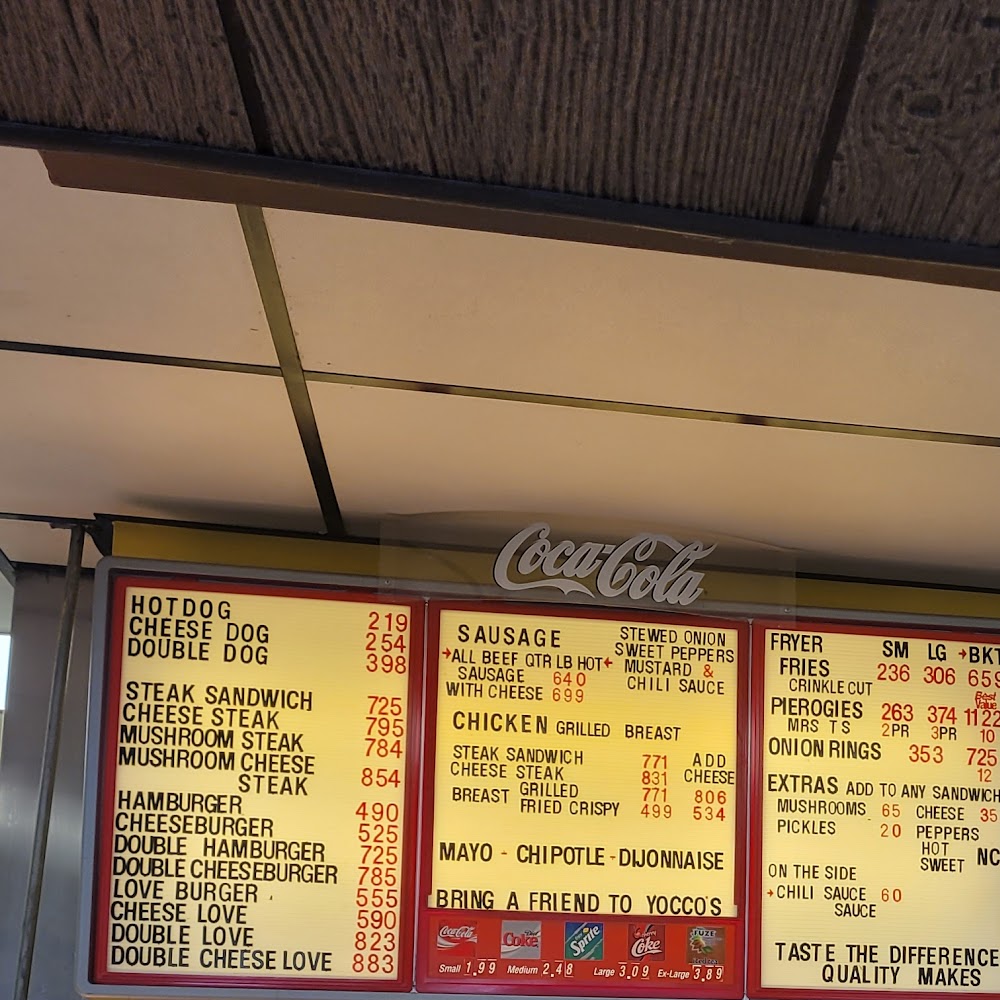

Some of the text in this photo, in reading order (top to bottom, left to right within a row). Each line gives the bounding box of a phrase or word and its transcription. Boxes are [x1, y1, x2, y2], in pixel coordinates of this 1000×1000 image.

[129, 616, 406, 653] CHEESE DOG 254
[458, 624, 561, 648] SAUSAGE
[771, 633, 823, 653] FRYER
[883, 640, 908, 659] SM
[928, 643, 946, 661] LG
[780, 658, 830, 677] FRIES
[877, 663, 910, 681] 236
[924, 666, 955, 685] 306
[446, 682, 584, 703] WITH CHEESE 699
[789, 678, 873, 696] CRINKLE CUT
[452, 711, 681, 741] CHICKEN GRILLED BREAST
[768, 774, 1000, 803] EXTRAS ADD TO ANY SANDWICH
[118, 791, 398, 822] HAMBURGER 490
[777, 799, 900, 818] MUSHROOMS 65
[115, 813, 398, 843] CHEESEBURGER 525
[113, 879, 397, 908] LOVE BURGER 555
[436, 889, 494, 910] BRING
[507, 892, 519, 910] A
[529, 892, 600, 913] FRIEND
[609, 895, 632, 913] TO
[503, 932, 538, 947] Coke
[570, 924, 601, 956] Sprite
[111, 946, 394, 973] DOUBLE CHEESE LOVE 883
[775, 943, 999, 967] TASTE THE DIFFERENCE
[439, 965, 461, 973] Small
[507, 965, 538, 974] Medium
[594, 968, 615, 976] Large
[658, 969, 690, 978] Ex-Large
[822, 965, 981, 986] QUALITY MAKES
